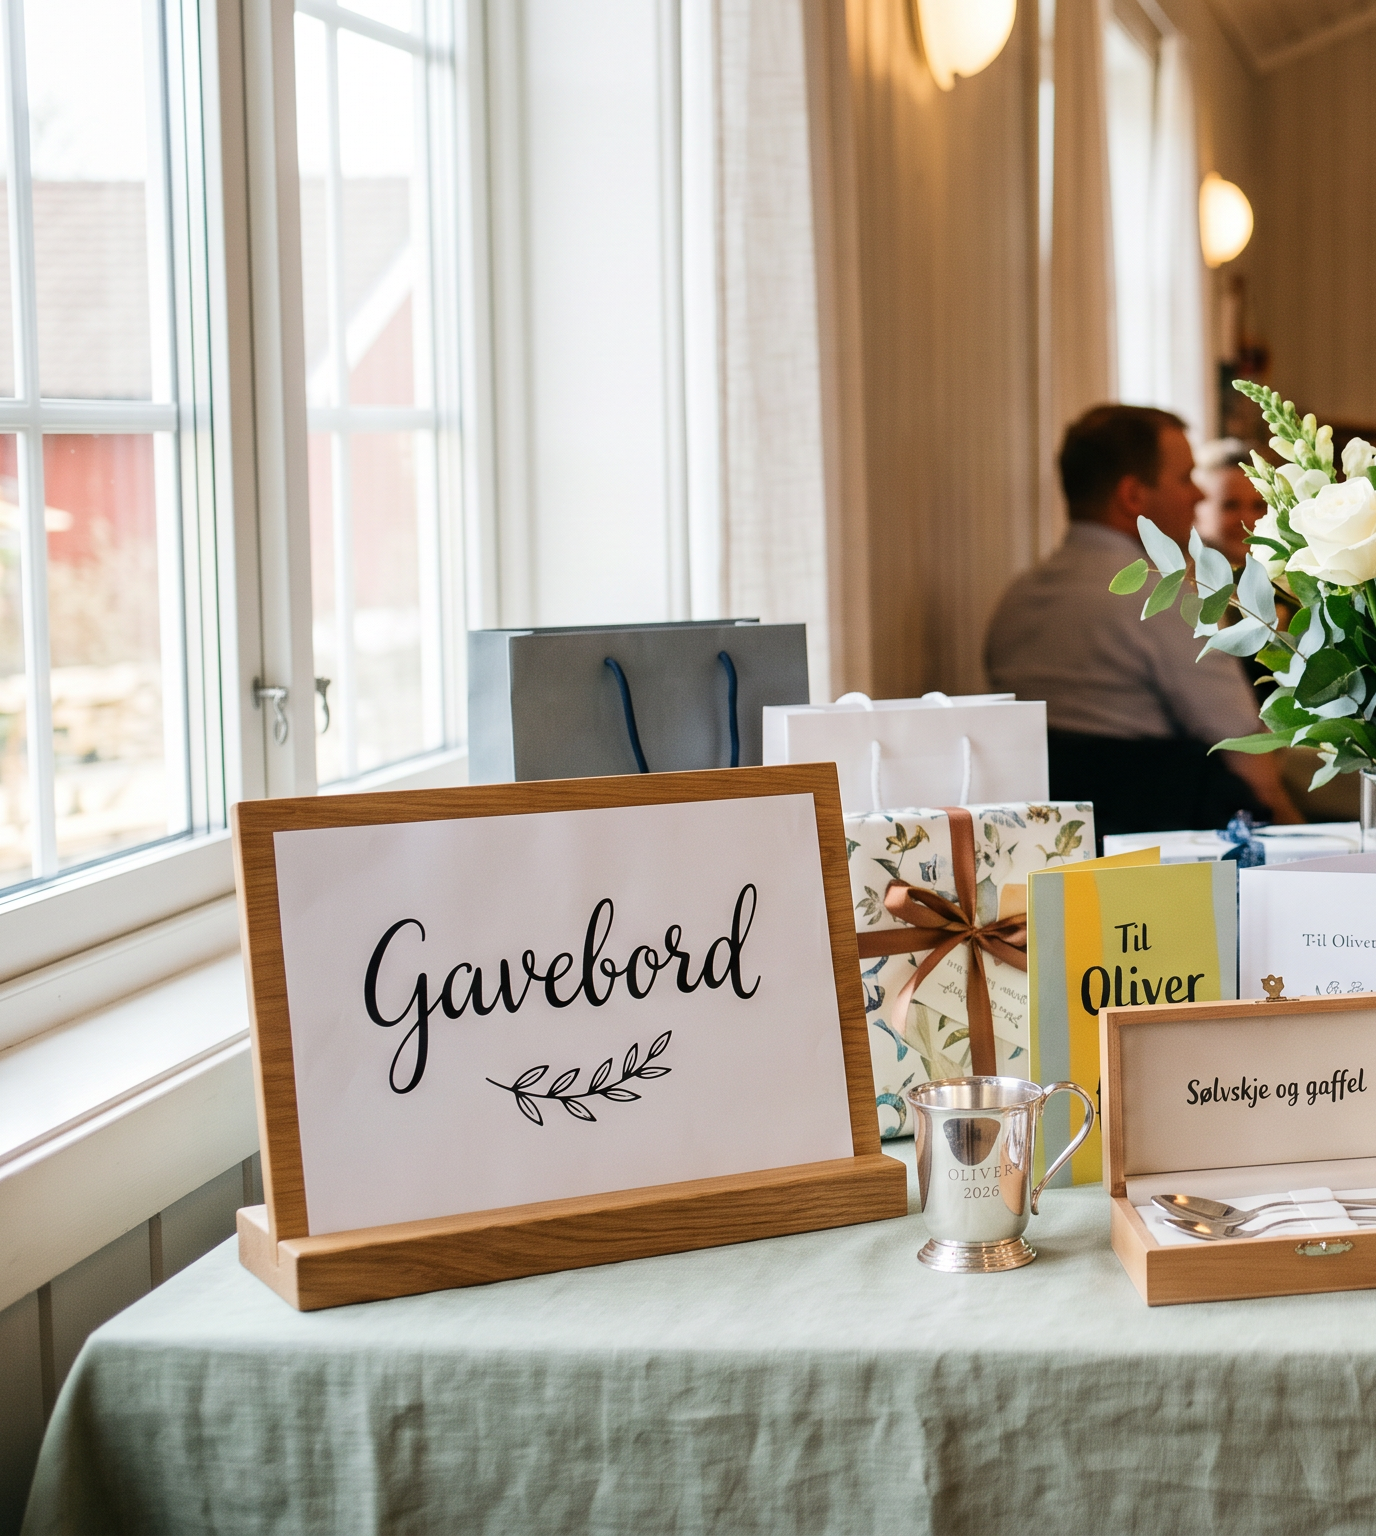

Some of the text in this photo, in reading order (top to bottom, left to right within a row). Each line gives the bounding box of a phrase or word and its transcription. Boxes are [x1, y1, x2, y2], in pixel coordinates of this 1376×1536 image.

[1114, 922, 1152, 953] Til
[363, 882, 762, 1095] Gavebord
[1081, 965, 1205, 1016] Oliver
[1186, 1067, 1368, 1109] Sølvskje og gaffel
[948, 1163, 1013, 1181] OLIVER
[963, 1185, 1000, 1199] 2026
